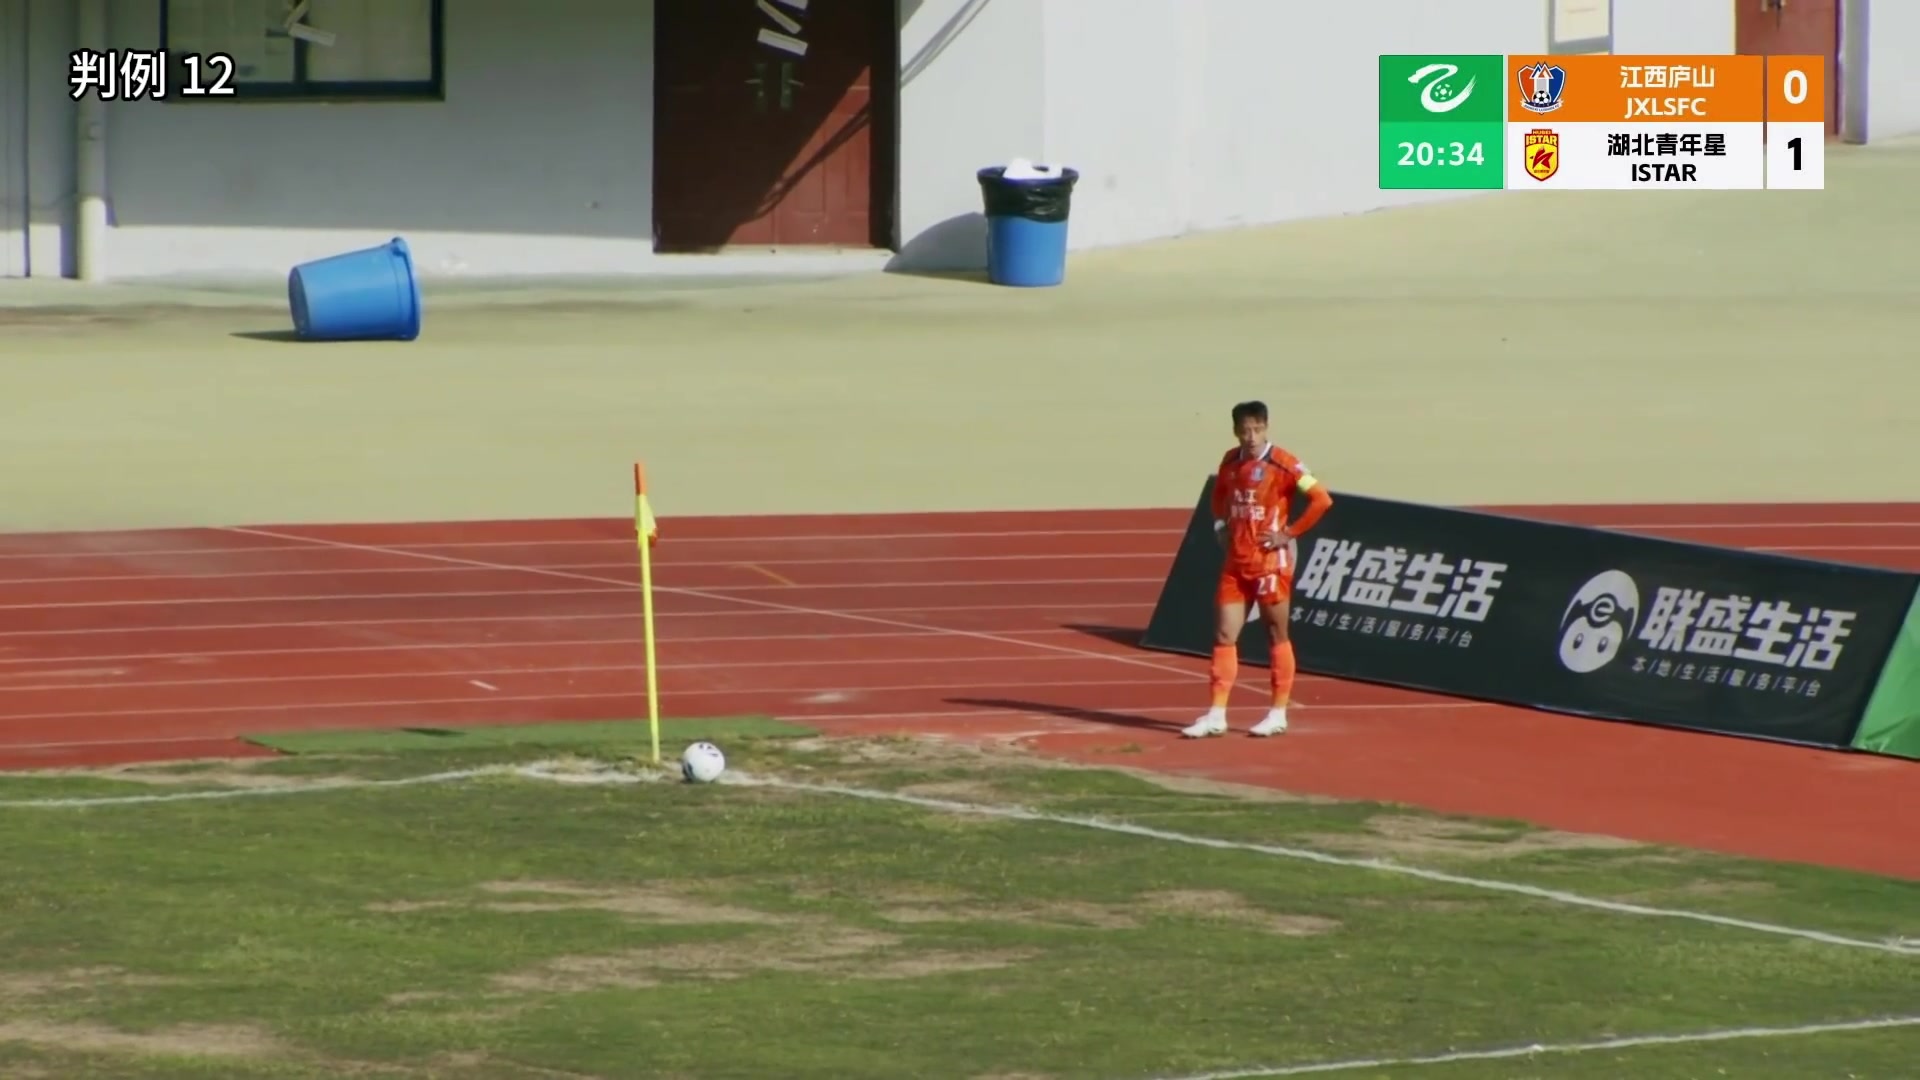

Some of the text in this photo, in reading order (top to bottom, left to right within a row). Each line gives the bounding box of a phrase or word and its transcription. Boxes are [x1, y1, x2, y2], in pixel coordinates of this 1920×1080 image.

[1257, 573, 1278, 595] 27
[1296, 537, 1508, 622] 联盛生活
[1638, 586, 1857, 671] 联盛生活
